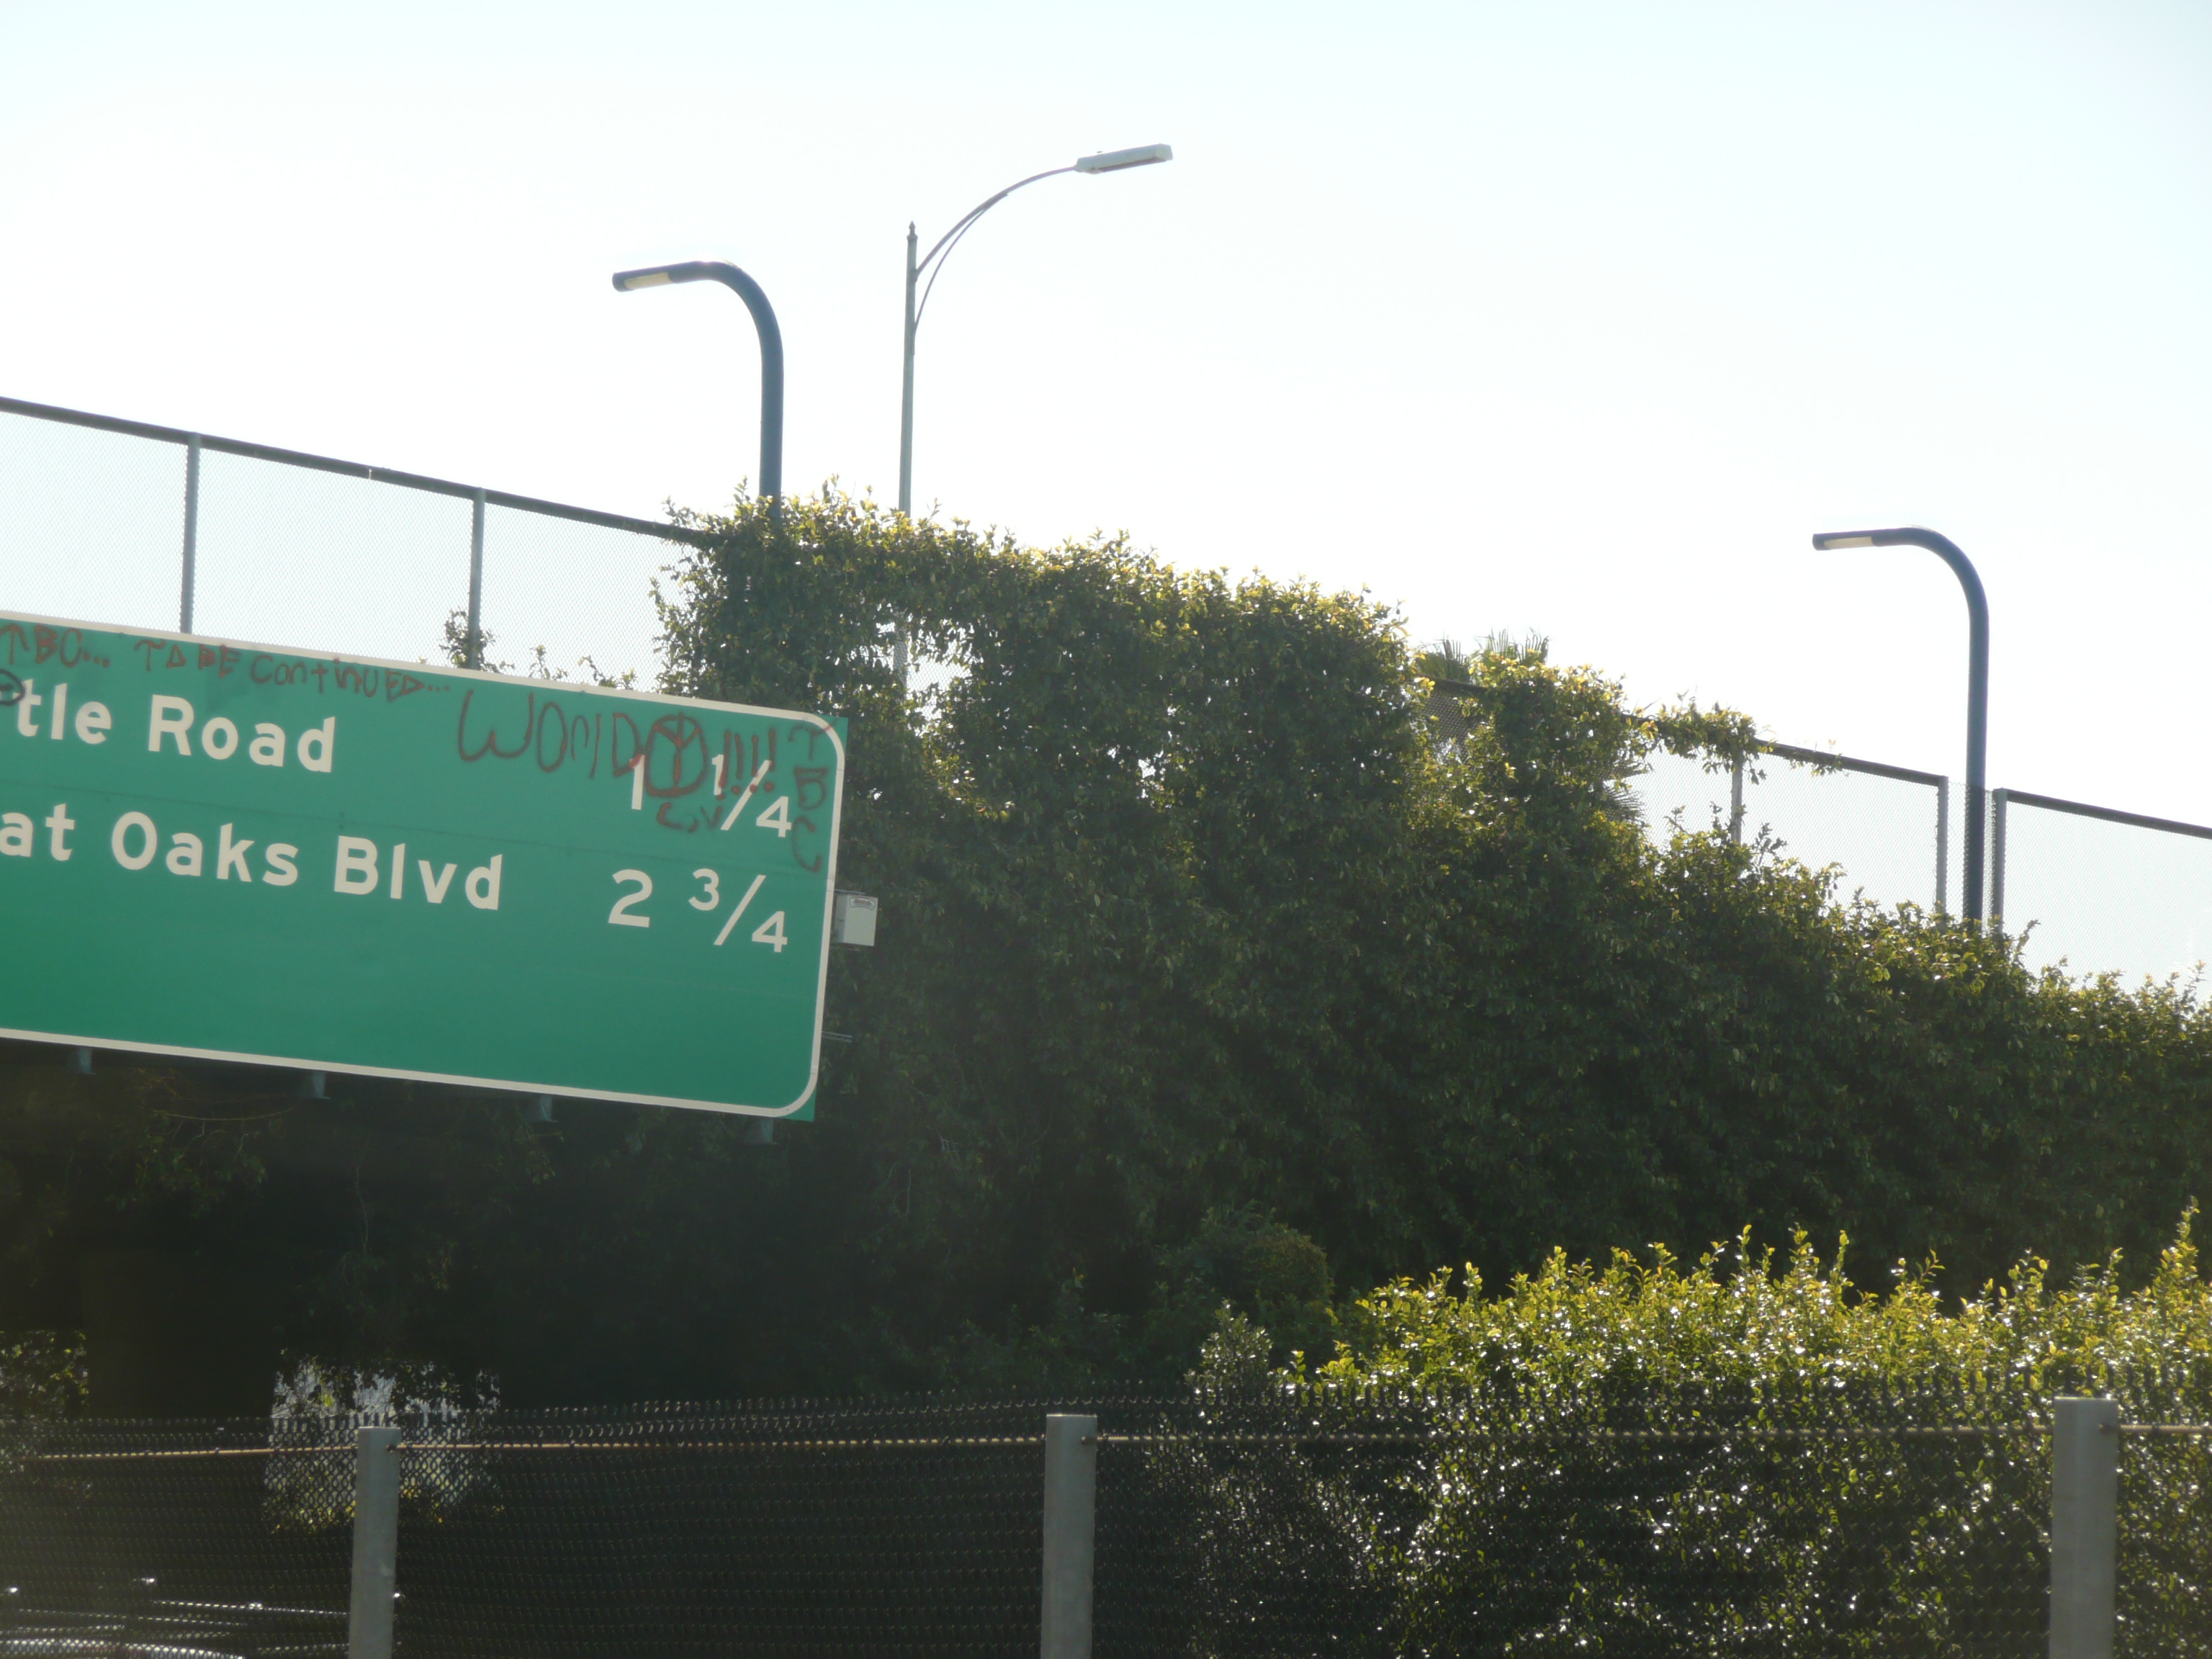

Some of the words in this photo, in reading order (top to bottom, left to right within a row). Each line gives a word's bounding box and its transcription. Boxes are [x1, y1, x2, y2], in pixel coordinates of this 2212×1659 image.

[0, 678, 112, 745] tle
[148, 694, 336, 773] Road
[112, 811, 299, 886] Oaks
[334, 835, 503, 910] Blvd
[608, 868, 653, 928] 2
